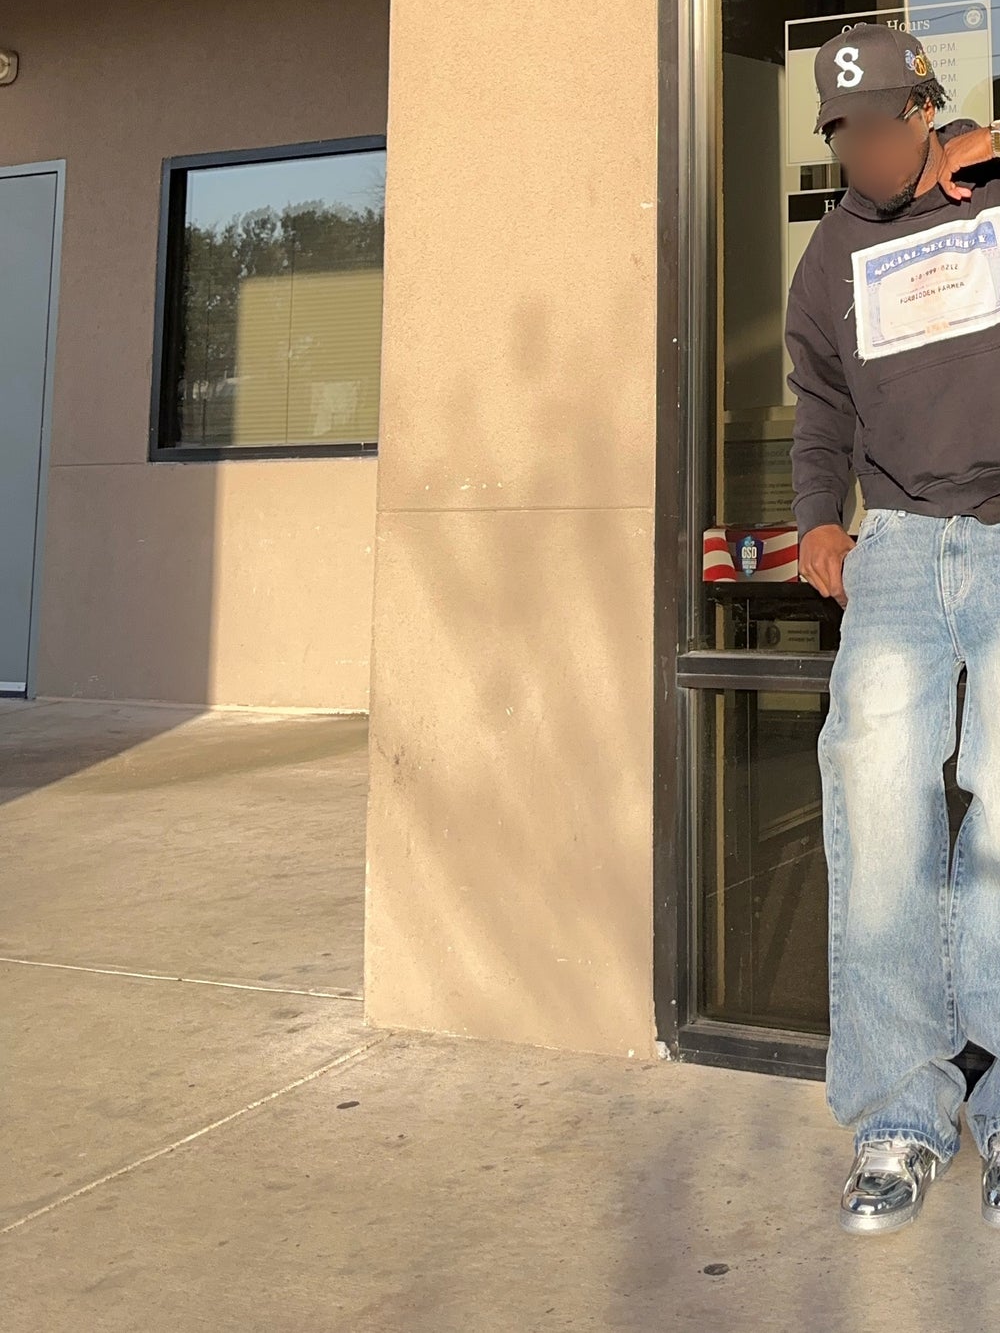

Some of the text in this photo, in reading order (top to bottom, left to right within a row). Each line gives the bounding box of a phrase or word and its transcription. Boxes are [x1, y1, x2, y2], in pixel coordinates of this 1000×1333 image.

[834, 47, 864, 88] S
[874, 234, 988, 277] SOCIAL SECURITY
[899, 289, 936, 304] FORBIDDEN
[937, 281, 965, 293] FARMER
[741, 546, 758, 559] GSD
